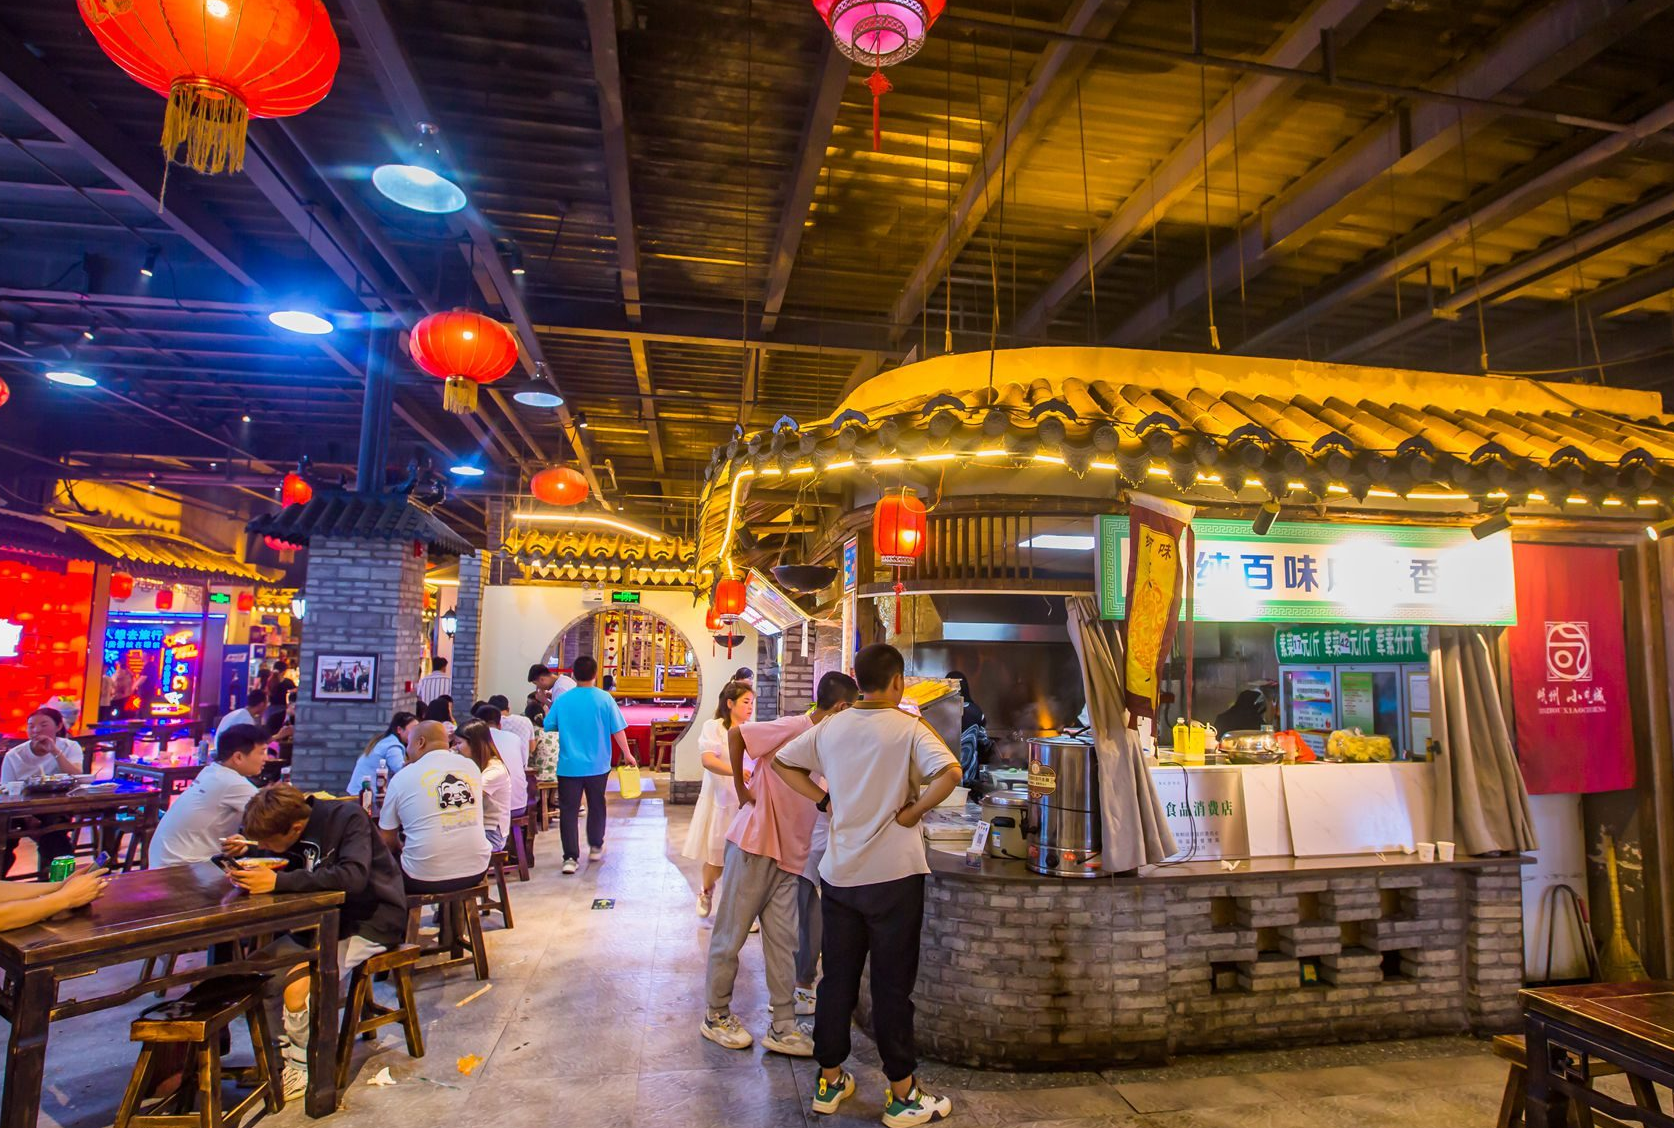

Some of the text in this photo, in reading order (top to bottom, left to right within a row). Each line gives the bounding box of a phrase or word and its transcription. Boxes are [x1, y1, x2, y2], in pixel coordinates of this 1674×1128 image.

[1166, 800, 1233, 817] 食品消费店
